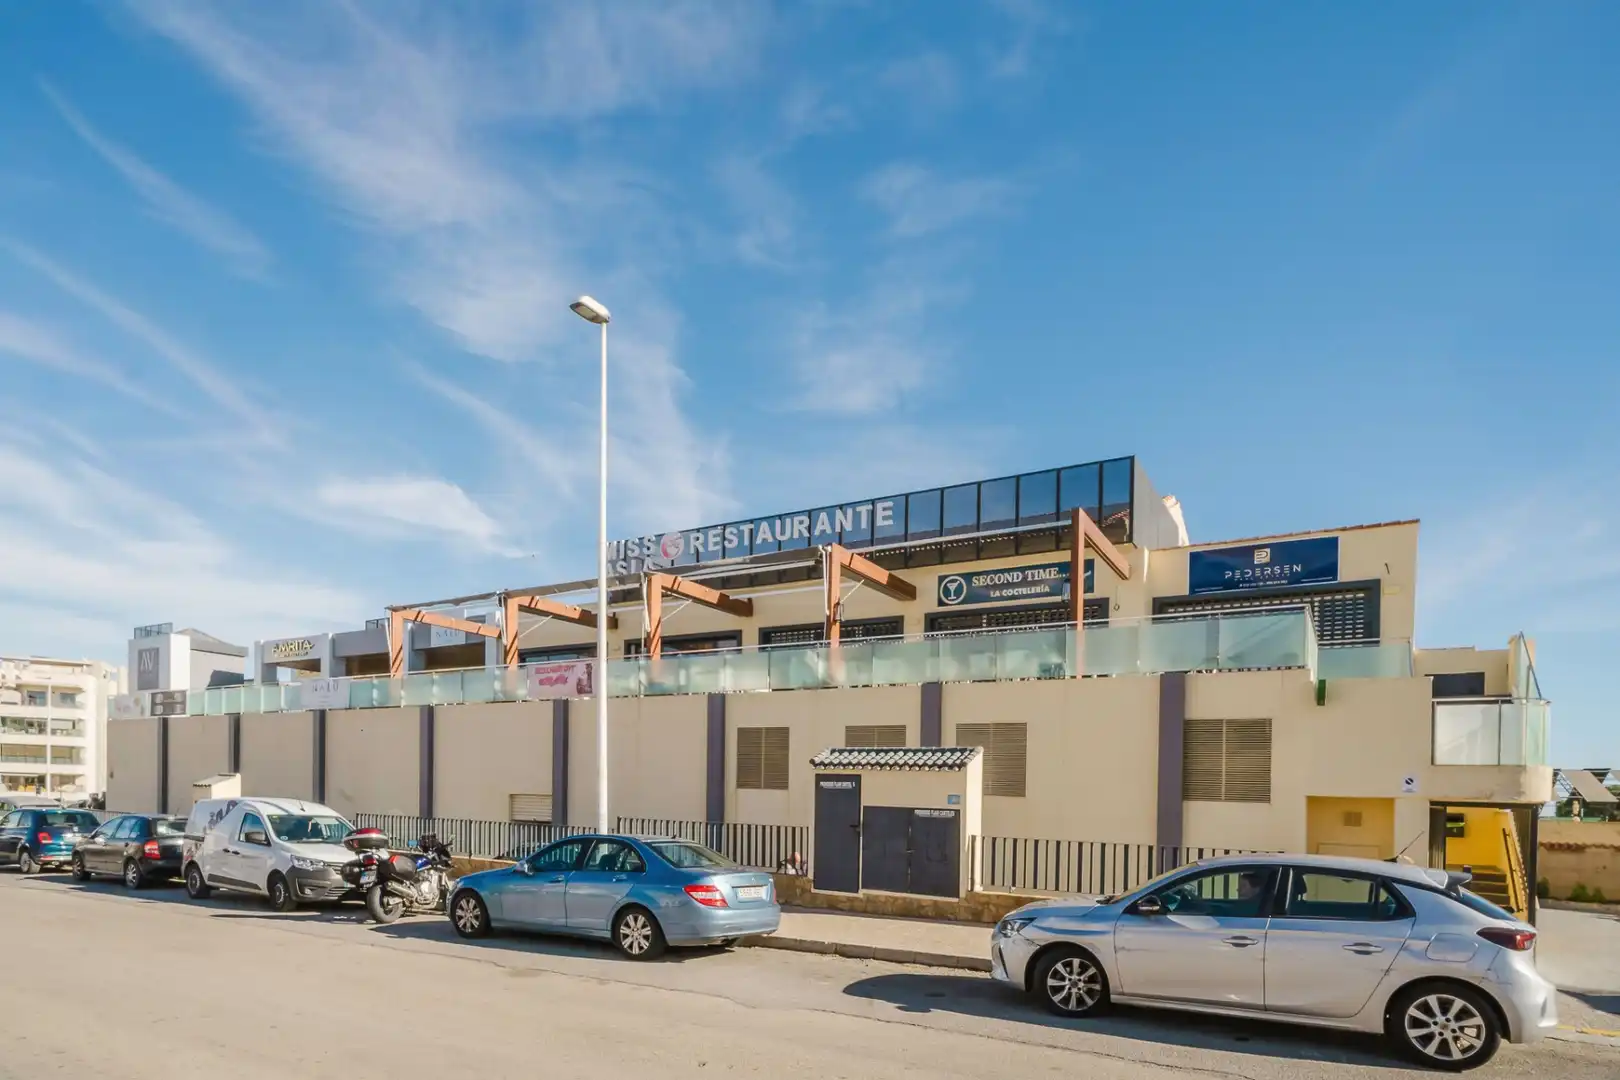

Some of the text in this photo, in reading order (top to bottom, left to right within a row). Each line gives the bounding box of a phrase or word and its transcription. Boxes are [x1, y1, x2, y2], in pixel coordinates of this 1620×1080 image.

[689, 501, 894, 554] RESTAURANTE
[1224, 563, 1302, 579] PEDERSEN
[972, 572, 1022, 587] SECOND
[990, 590, 1001, 598] LA
[272, 639, 314, 656] AMRITA
